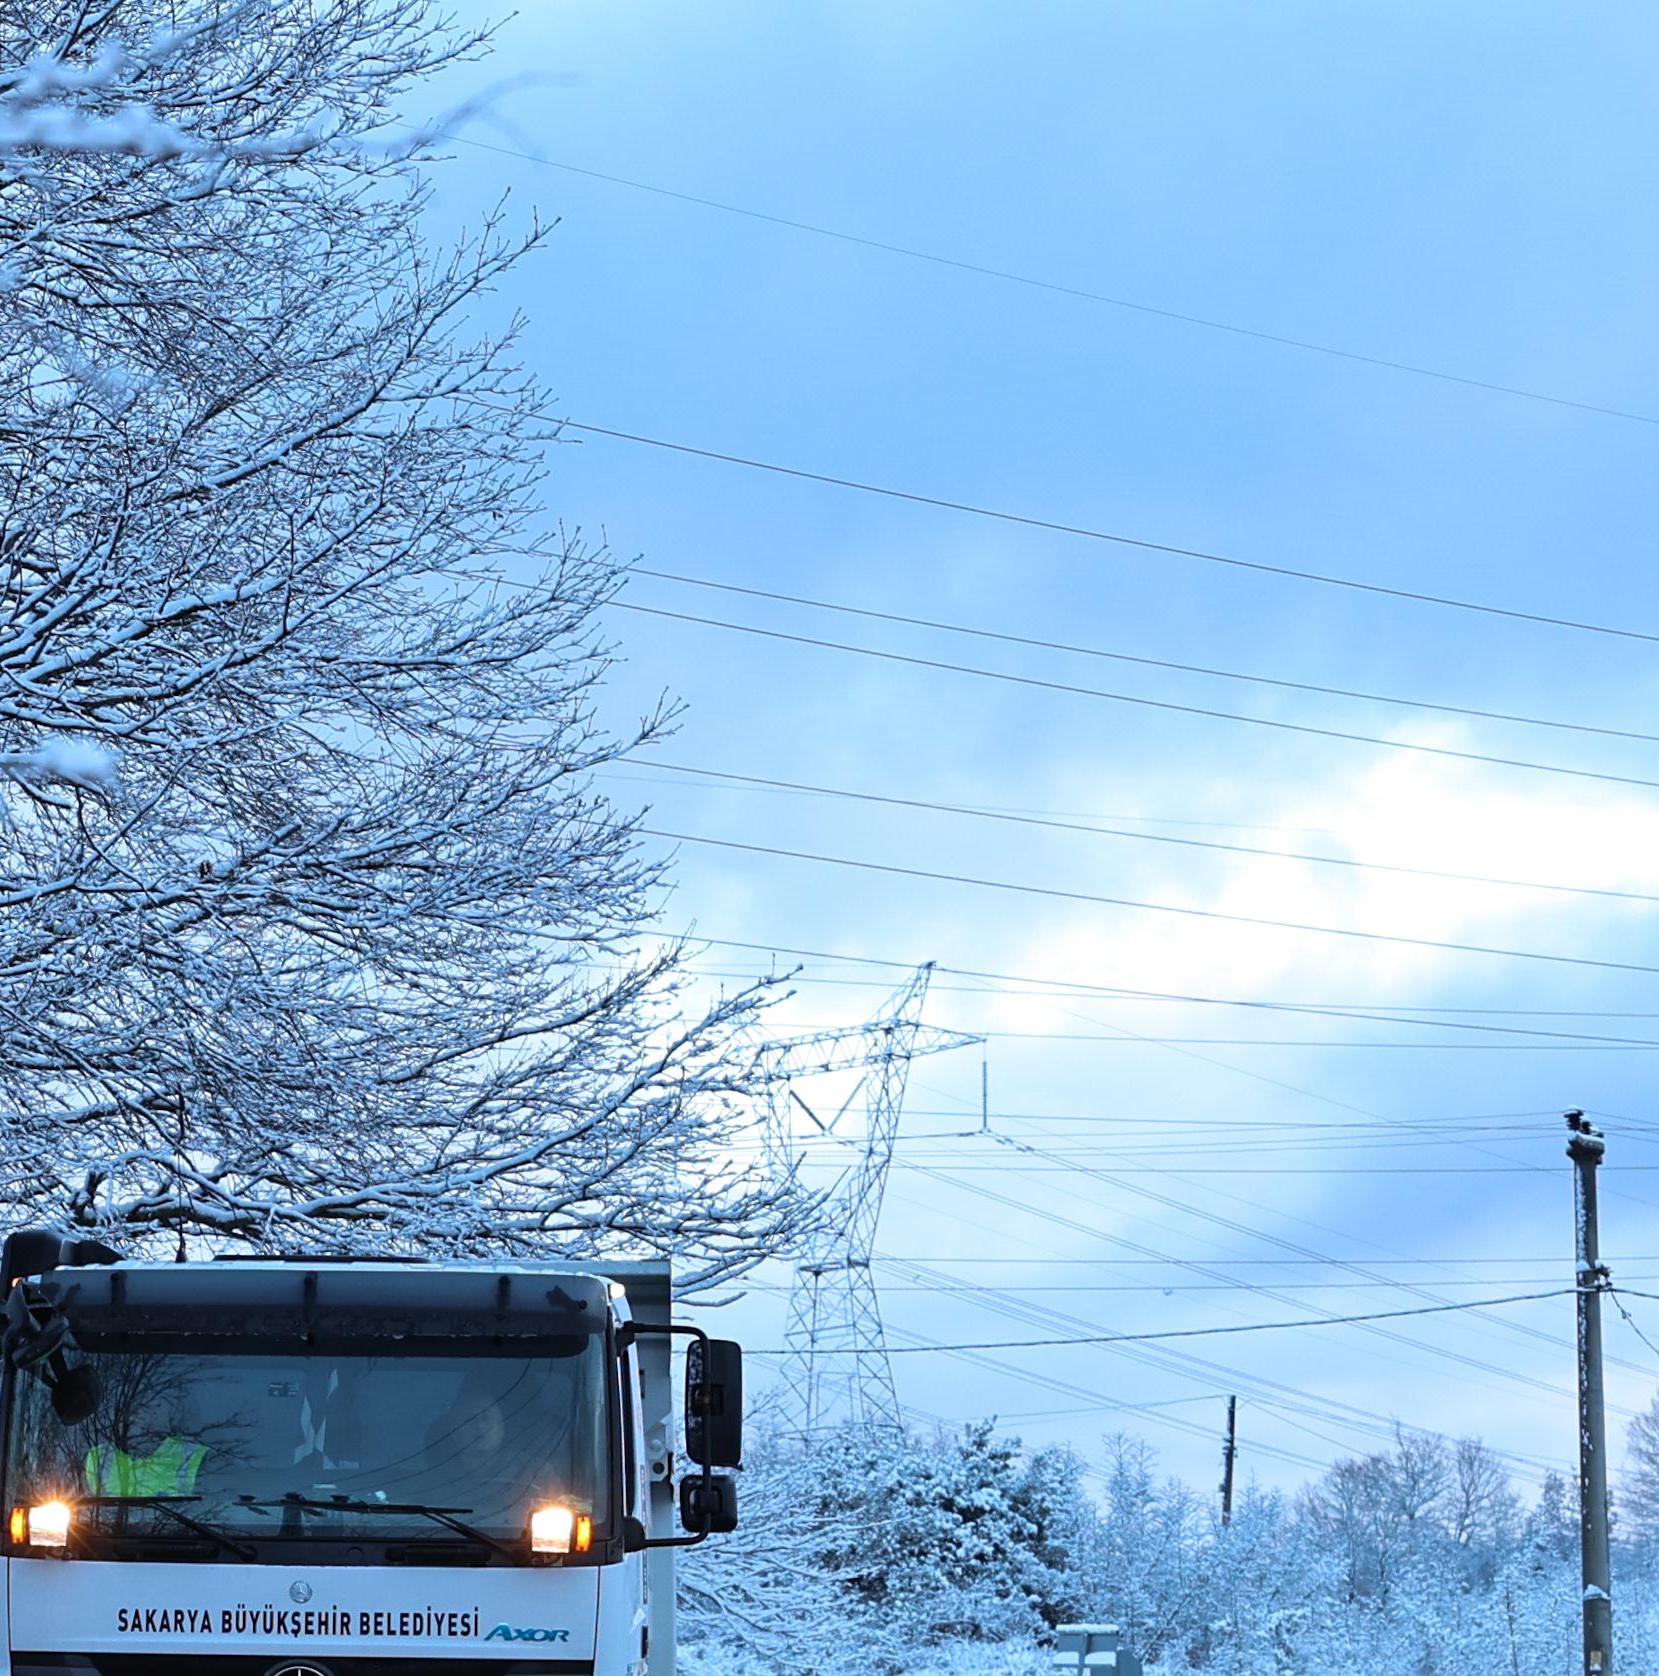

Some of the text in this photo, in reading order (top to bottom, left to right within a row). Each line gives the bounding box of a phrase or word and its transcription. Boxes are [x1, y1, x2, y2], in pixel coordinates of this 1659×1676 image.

[117, 1604, 479, 1638] SAKARYA BÜYÜKŞEHİR BELEDİYESİ
